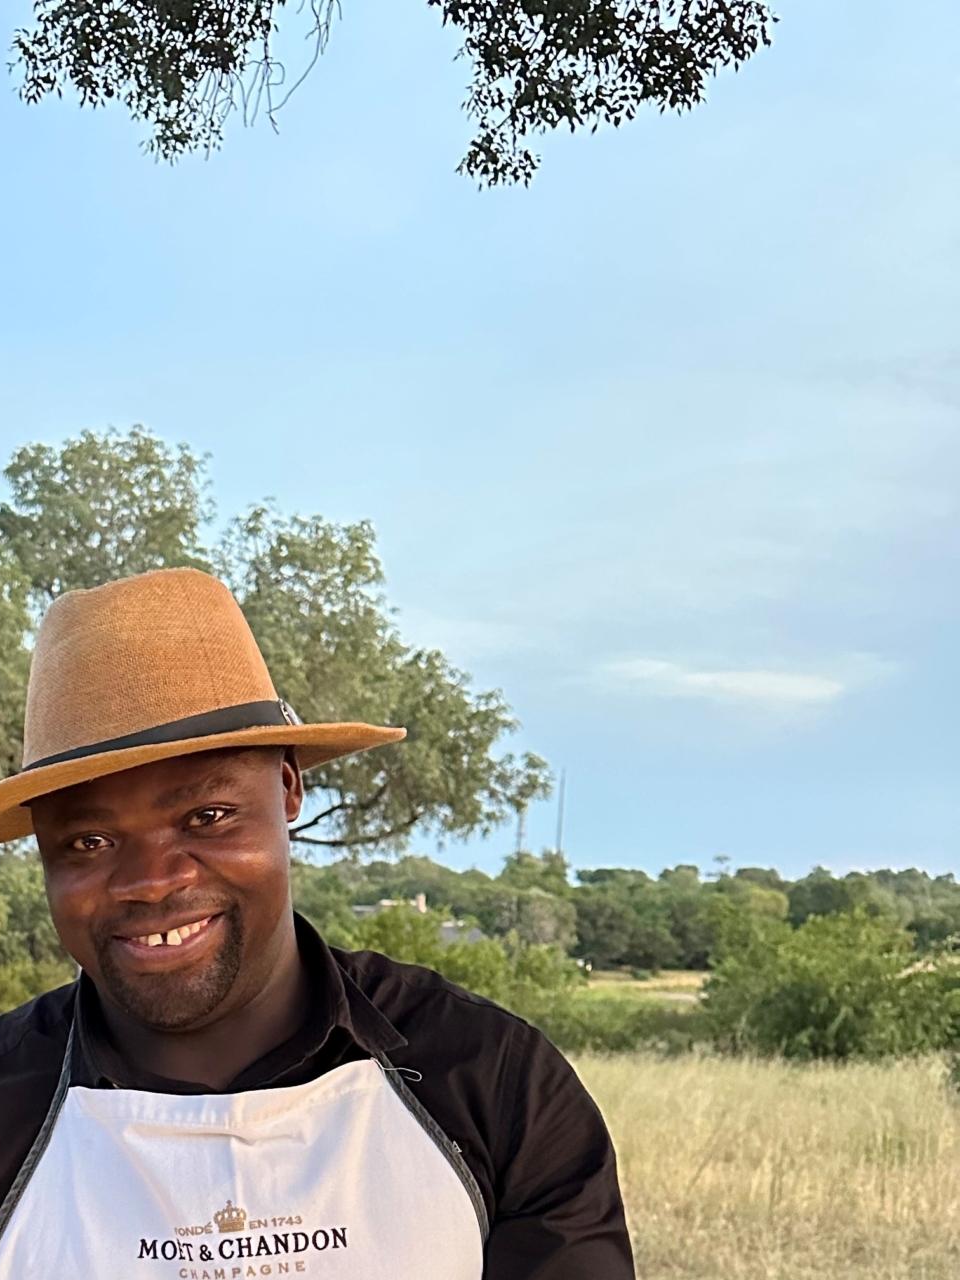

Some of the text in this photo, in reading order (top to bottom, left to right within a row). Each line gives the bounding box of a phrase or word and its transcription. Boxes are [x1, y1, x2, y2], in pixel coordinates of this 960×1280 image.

[248, 1219, 268, 1230] EN
[271, 1215, 303, 1227] 1743
[199, 1244, 214, 1262] &
[218, 1227, 348, 1260] CHANDON
[179, 1260, 306, 1280] CHAMPAGNE
